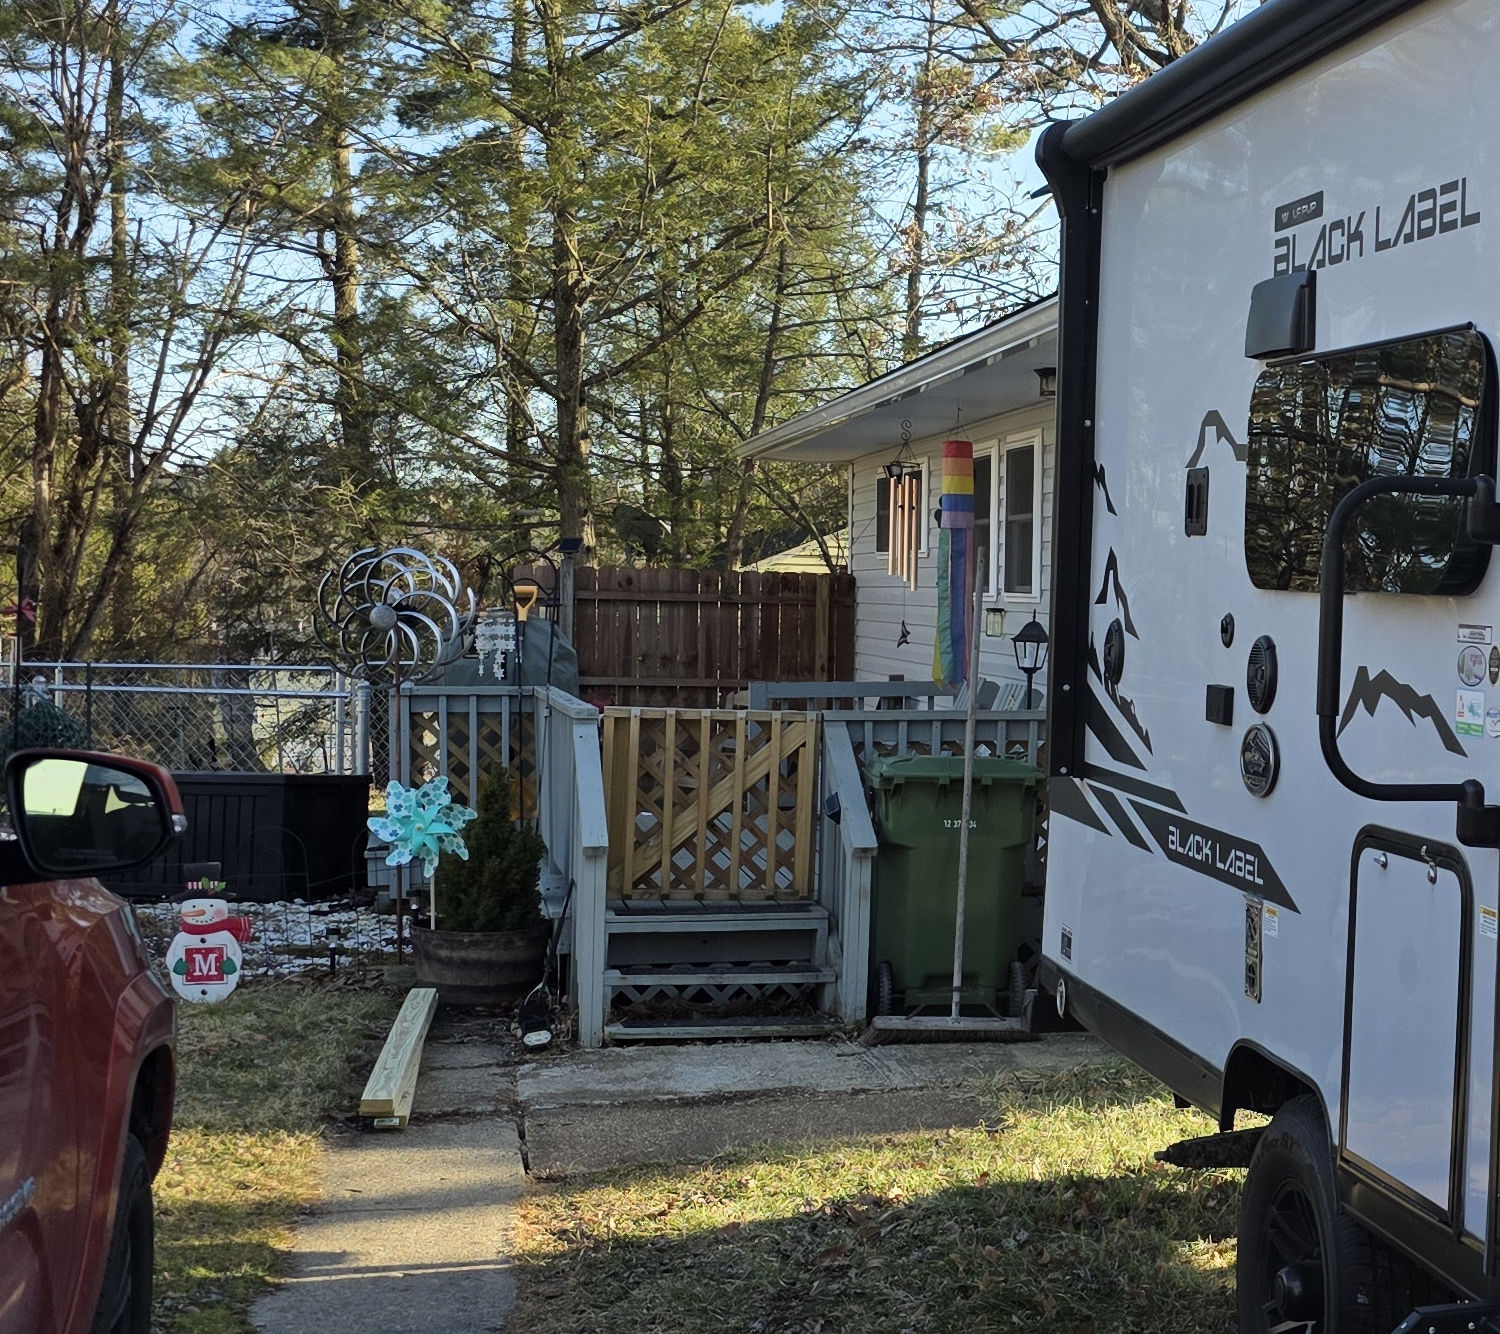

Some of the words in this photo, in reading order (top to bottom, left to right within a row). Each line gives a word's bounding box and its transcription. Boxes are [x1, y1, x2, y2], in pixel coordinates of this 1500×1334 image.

[1273, 210, 1367, 278] BLACK
[1374, 176, 1481, 253] LABEL
[1168, 825, 1212, 865] BLACK
[1216, 842, 1264, 886] LABEL
[192, 953, 219, 978] M
